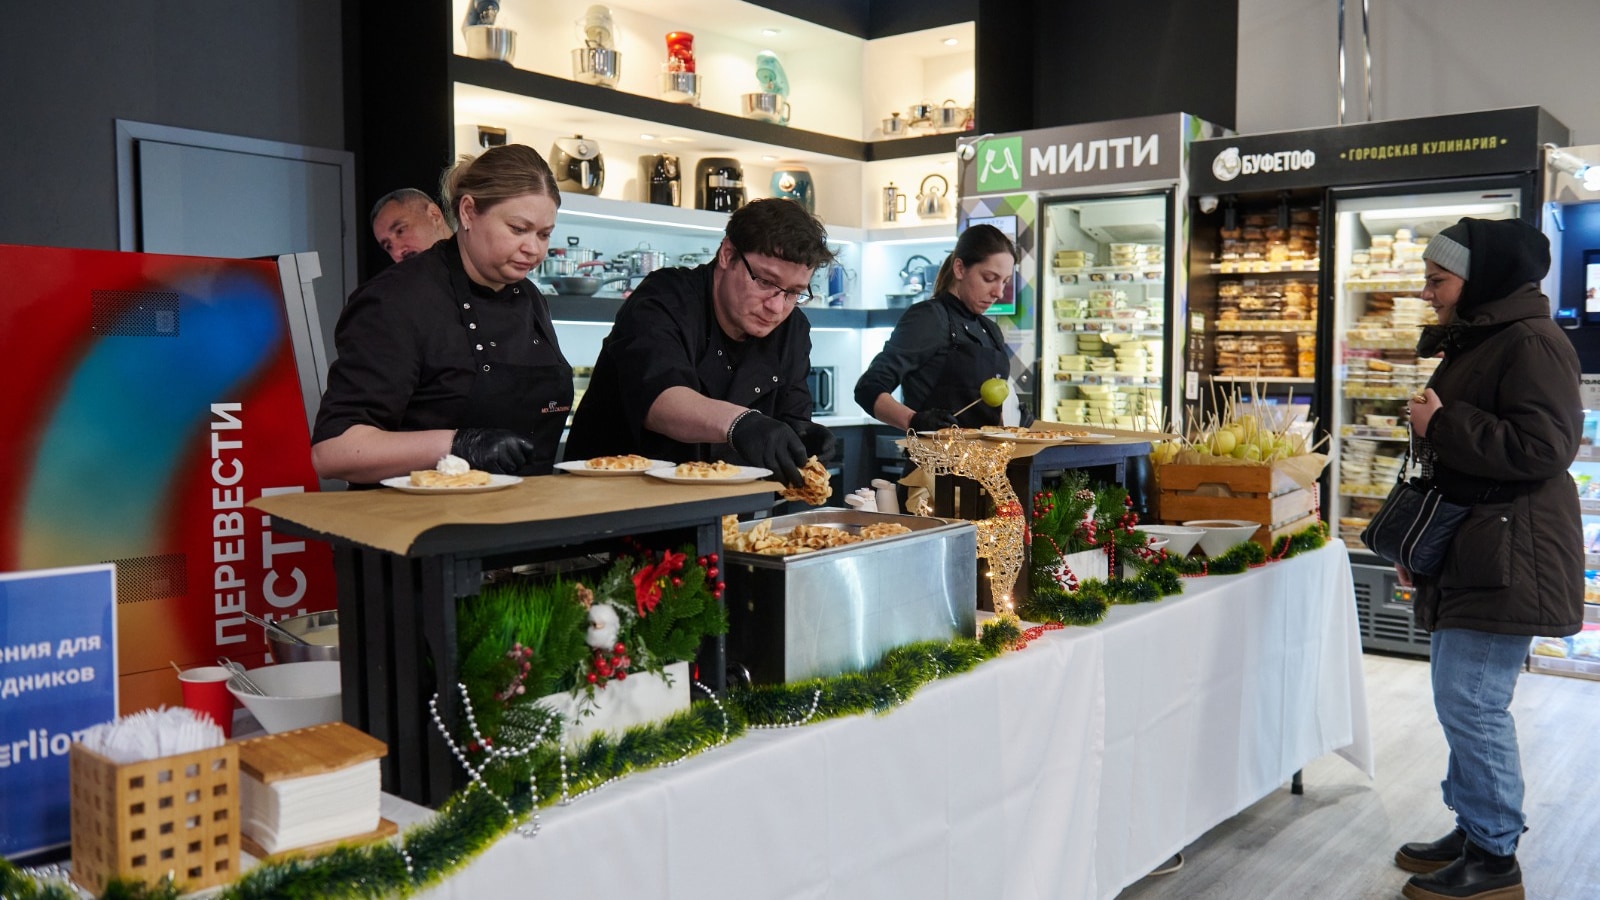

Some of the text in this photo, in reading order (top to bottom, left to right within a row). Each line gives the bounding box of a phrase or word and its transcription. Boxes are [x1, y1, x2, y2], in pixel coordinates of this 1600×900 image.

[1029, 133, 1159, 177] МИЛТИ
[1240, 148, 1316, 176] БУФЕТОФ
[1348, 136, 1498, 161] ГОРОДСКАЯ КУЛИНАРИЯ
[210, 402, 247, 646] ПЕРЕВЕСТИ
[0, 635, 101, 664] ния для
[0, 666, 96, 700] дников
